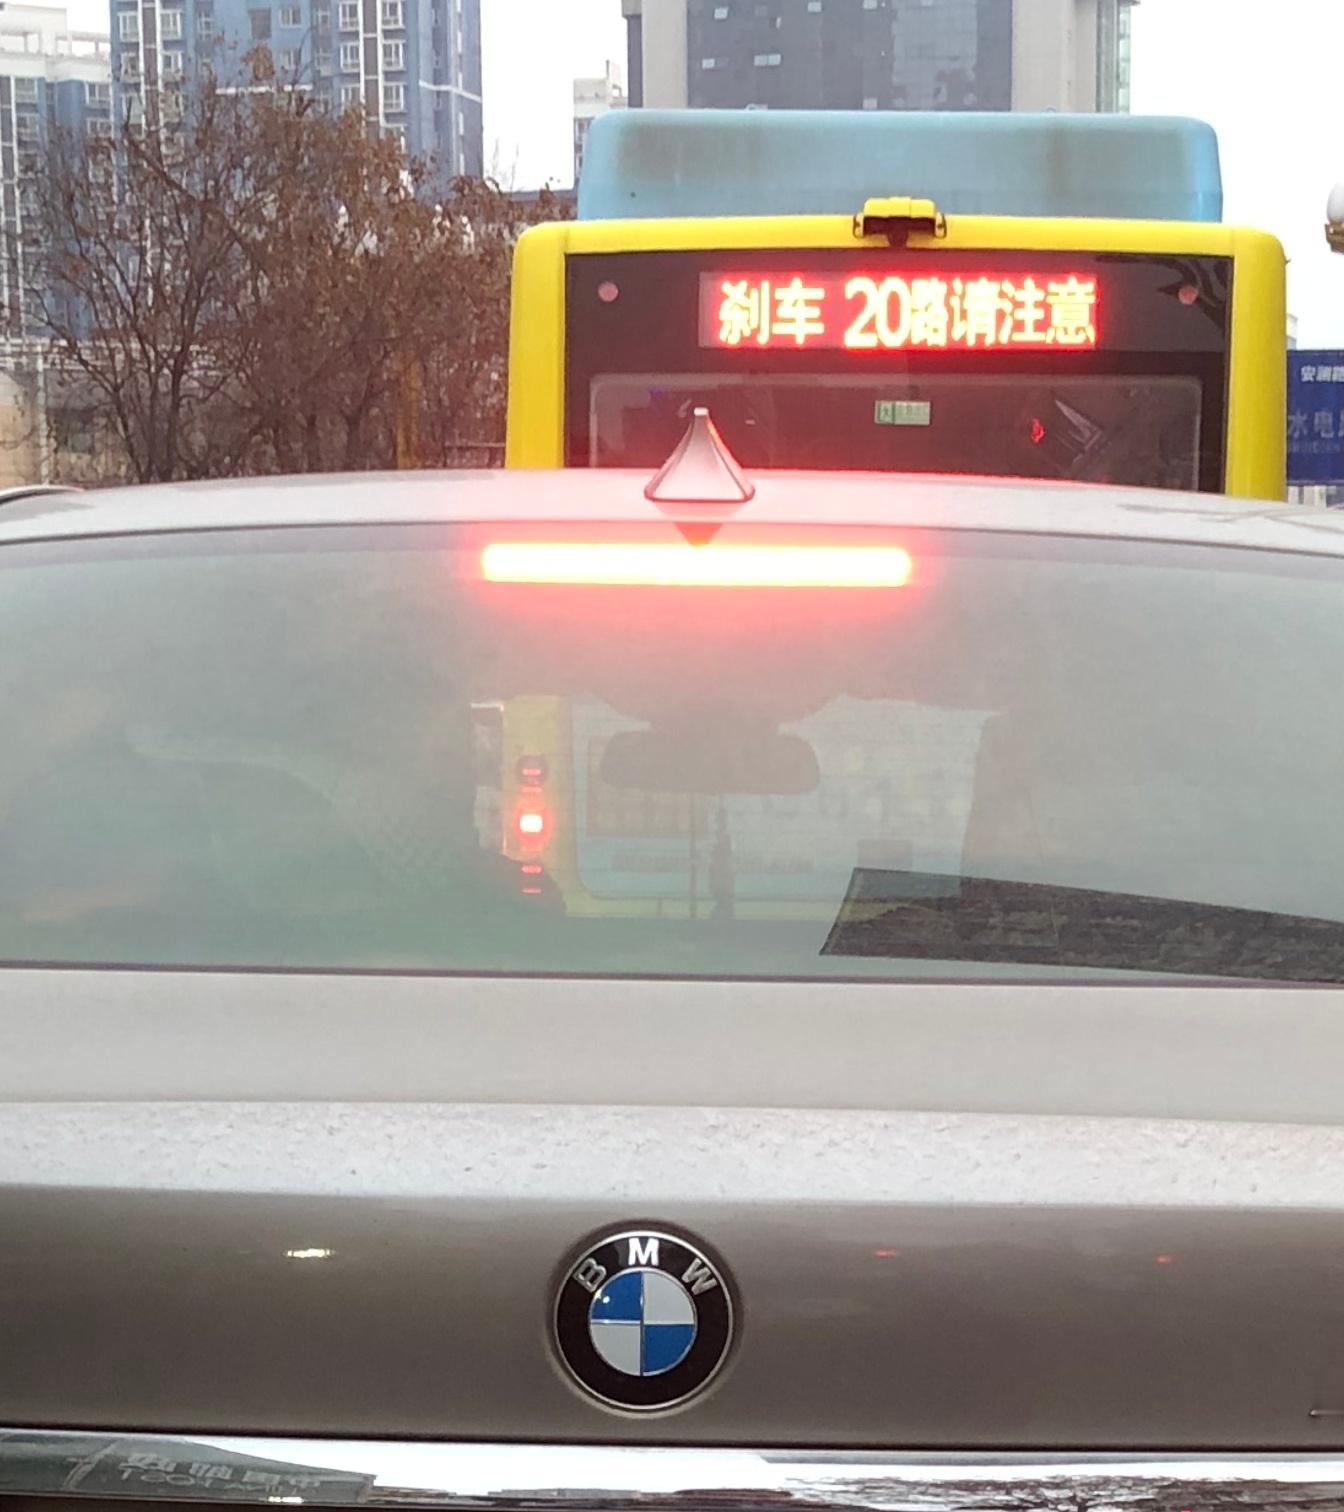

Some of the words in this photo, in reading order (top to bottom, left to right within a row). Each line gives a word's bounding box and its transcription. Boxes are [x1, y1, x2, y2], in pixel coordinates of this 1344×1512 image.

[717, 277, 826, 346] 刹车
[843, 275, 1097, 348] 20路请注意
[573, 1237, 718, 1296] BMW
